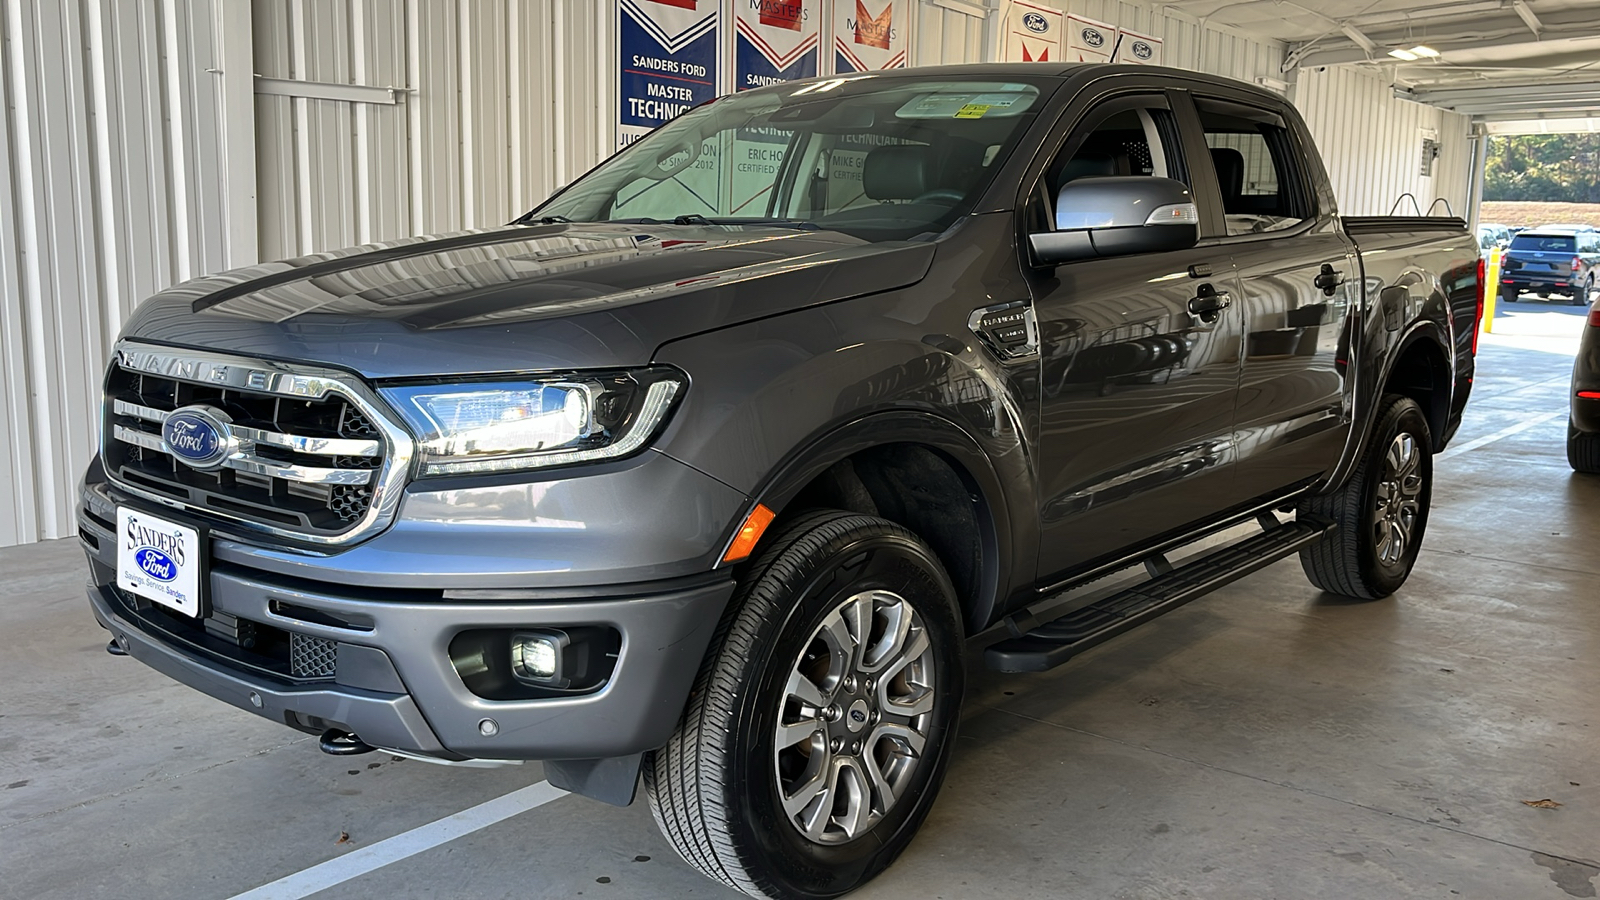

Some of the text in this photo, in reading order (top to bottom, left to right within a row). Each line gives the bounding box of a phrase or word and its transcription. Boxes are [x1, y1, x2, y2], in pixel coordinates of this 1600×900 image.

[750, 0, 808, 20] MASTERS
[1026, 13, 1047, 31] Ford
[633, 55, 706, 77] SANDERS FORD
[647, 83, 692, 101] MASTER
[748, 148, 767, 160] ERIC
[832, 155, 853, 167] MIKE
[695, 160, 714, 170] 2012
[737, 163, 775, 174] CERTIFIED
[983, 313, 1024, 326] RANGER
[123, 350, 309, 395] RANGER
[169, 419, 204, 452] Ford
[127, 521, 185, 567] SANDERS
[143, 550, 170, 579] Ford
